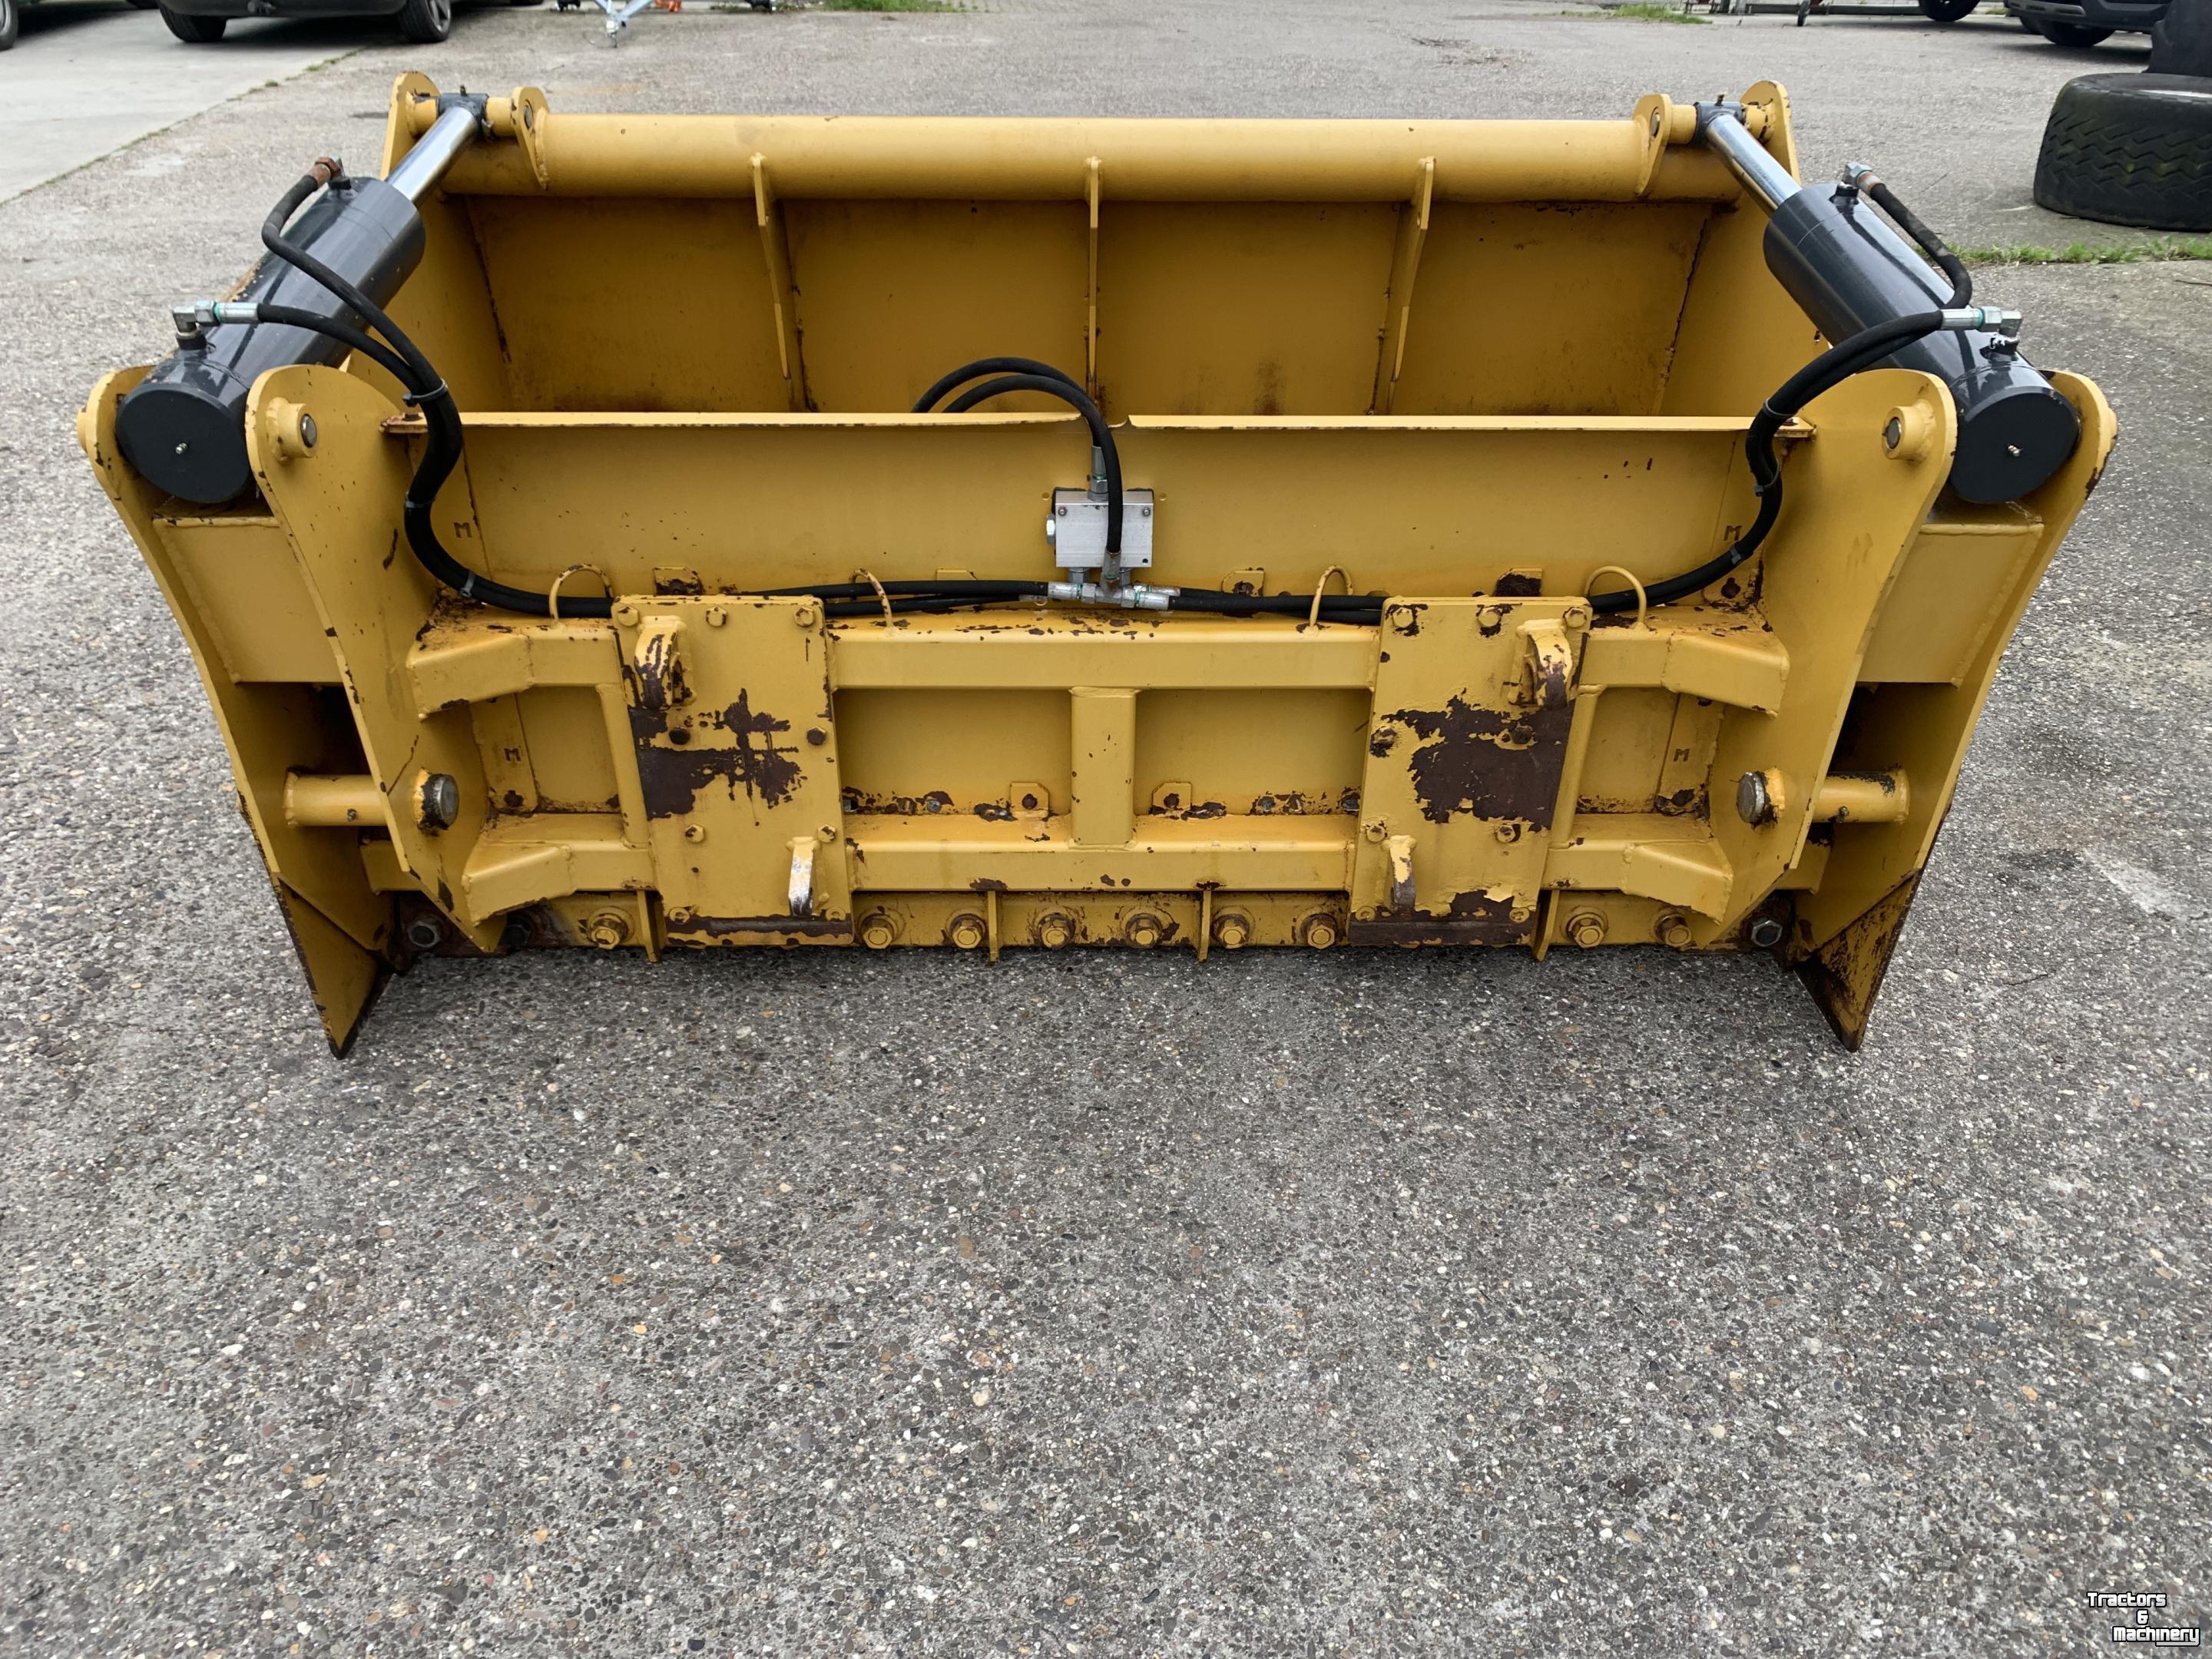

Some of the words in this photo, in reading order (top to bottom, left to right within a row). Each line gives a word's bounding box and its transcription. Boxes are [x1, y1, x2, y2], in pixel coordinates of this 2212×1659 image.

[453, 522, 472, 538] M
[1723, 525, 1743, 541] M
[503, 748, 522, 762] M
[1673, 748, 1690, 763] M
